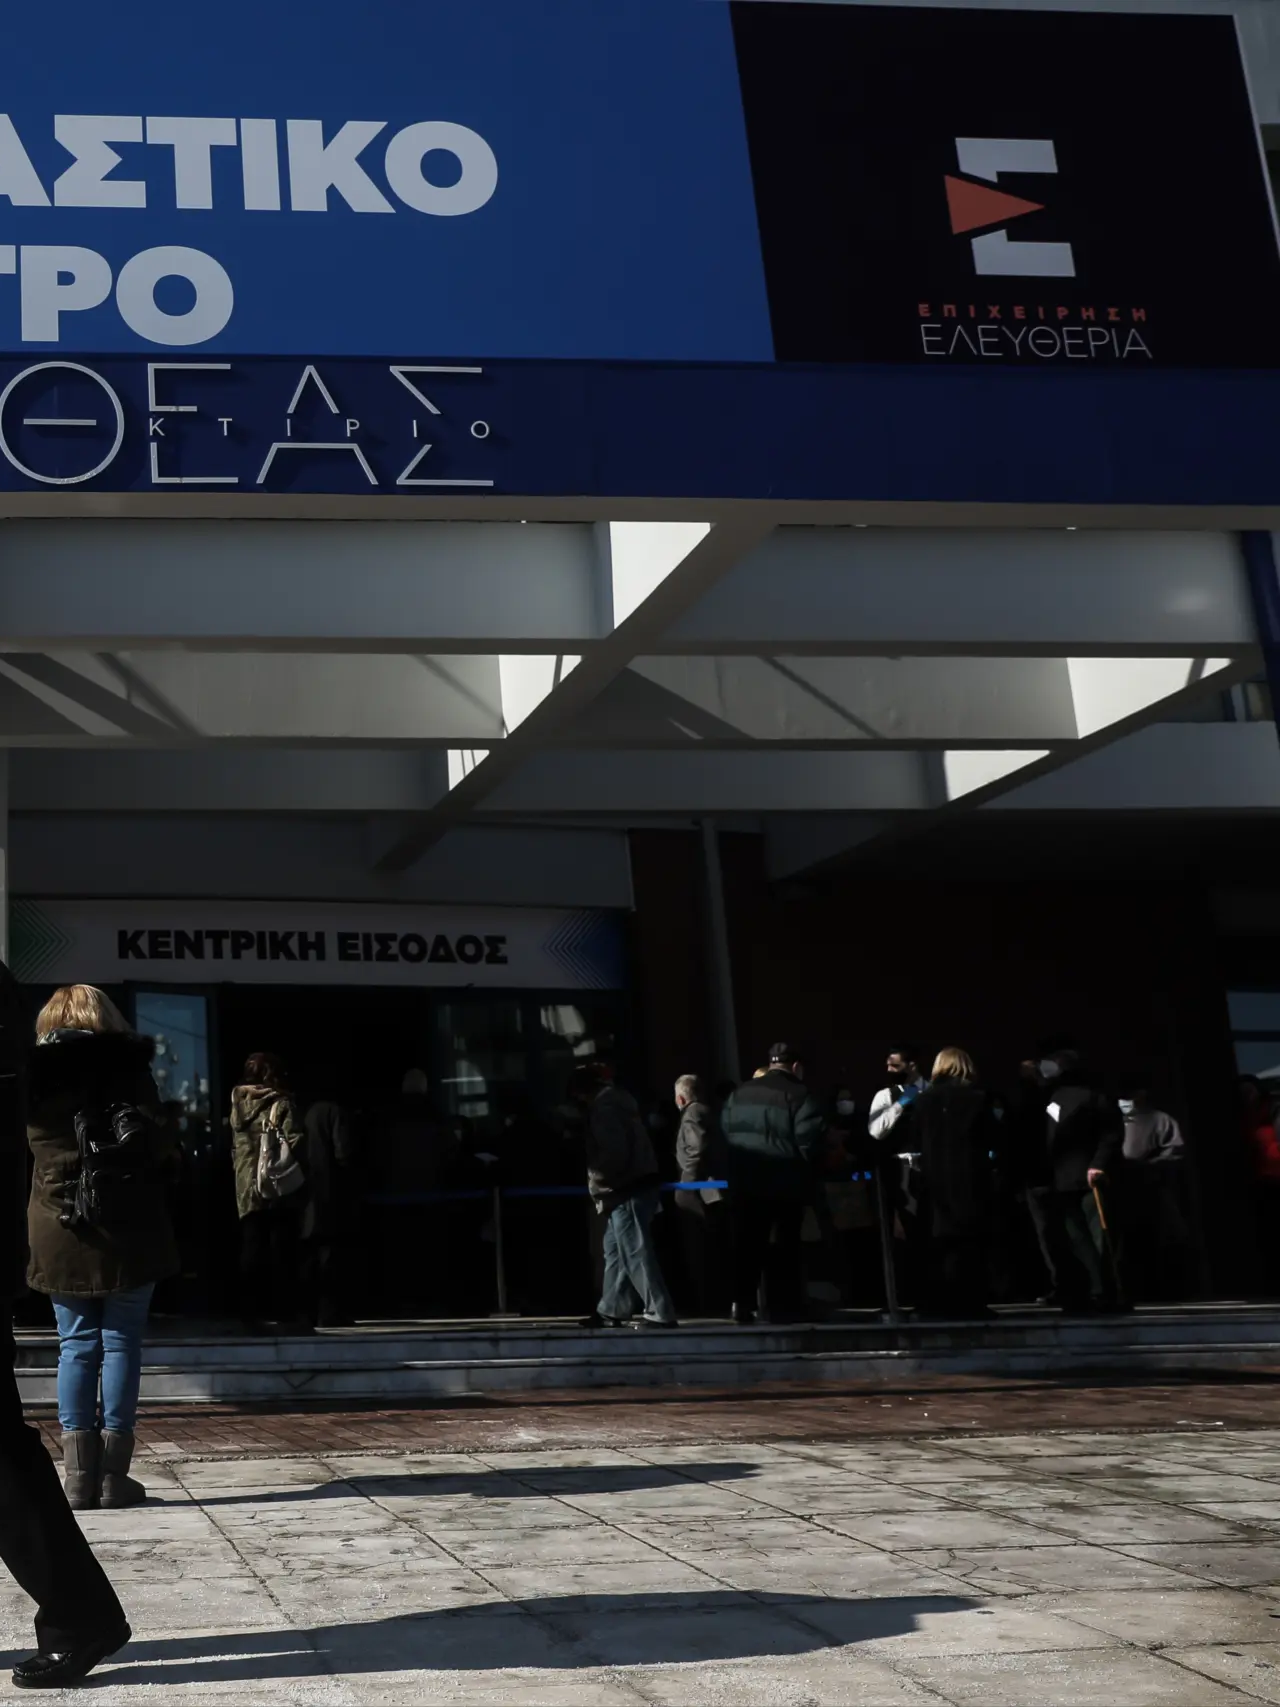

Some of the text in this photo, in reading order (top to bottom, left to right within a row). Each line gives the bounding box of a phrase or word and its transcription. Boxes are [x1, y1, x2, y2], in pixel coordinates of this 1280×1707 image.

[917, 302, 1148, 322] ΕΠΙΧΕΙΡΗΣΗ
[919, 323, 1153, 360] ΕΛΕΥΘΕΡΙΑ
[148, 416, 491, 440] ΚΤΙΡΙΟ
[117, 929, 509, 965] ΚΕΝΤΡΙΚΗ ΕΙΣΟΔΟΣ
